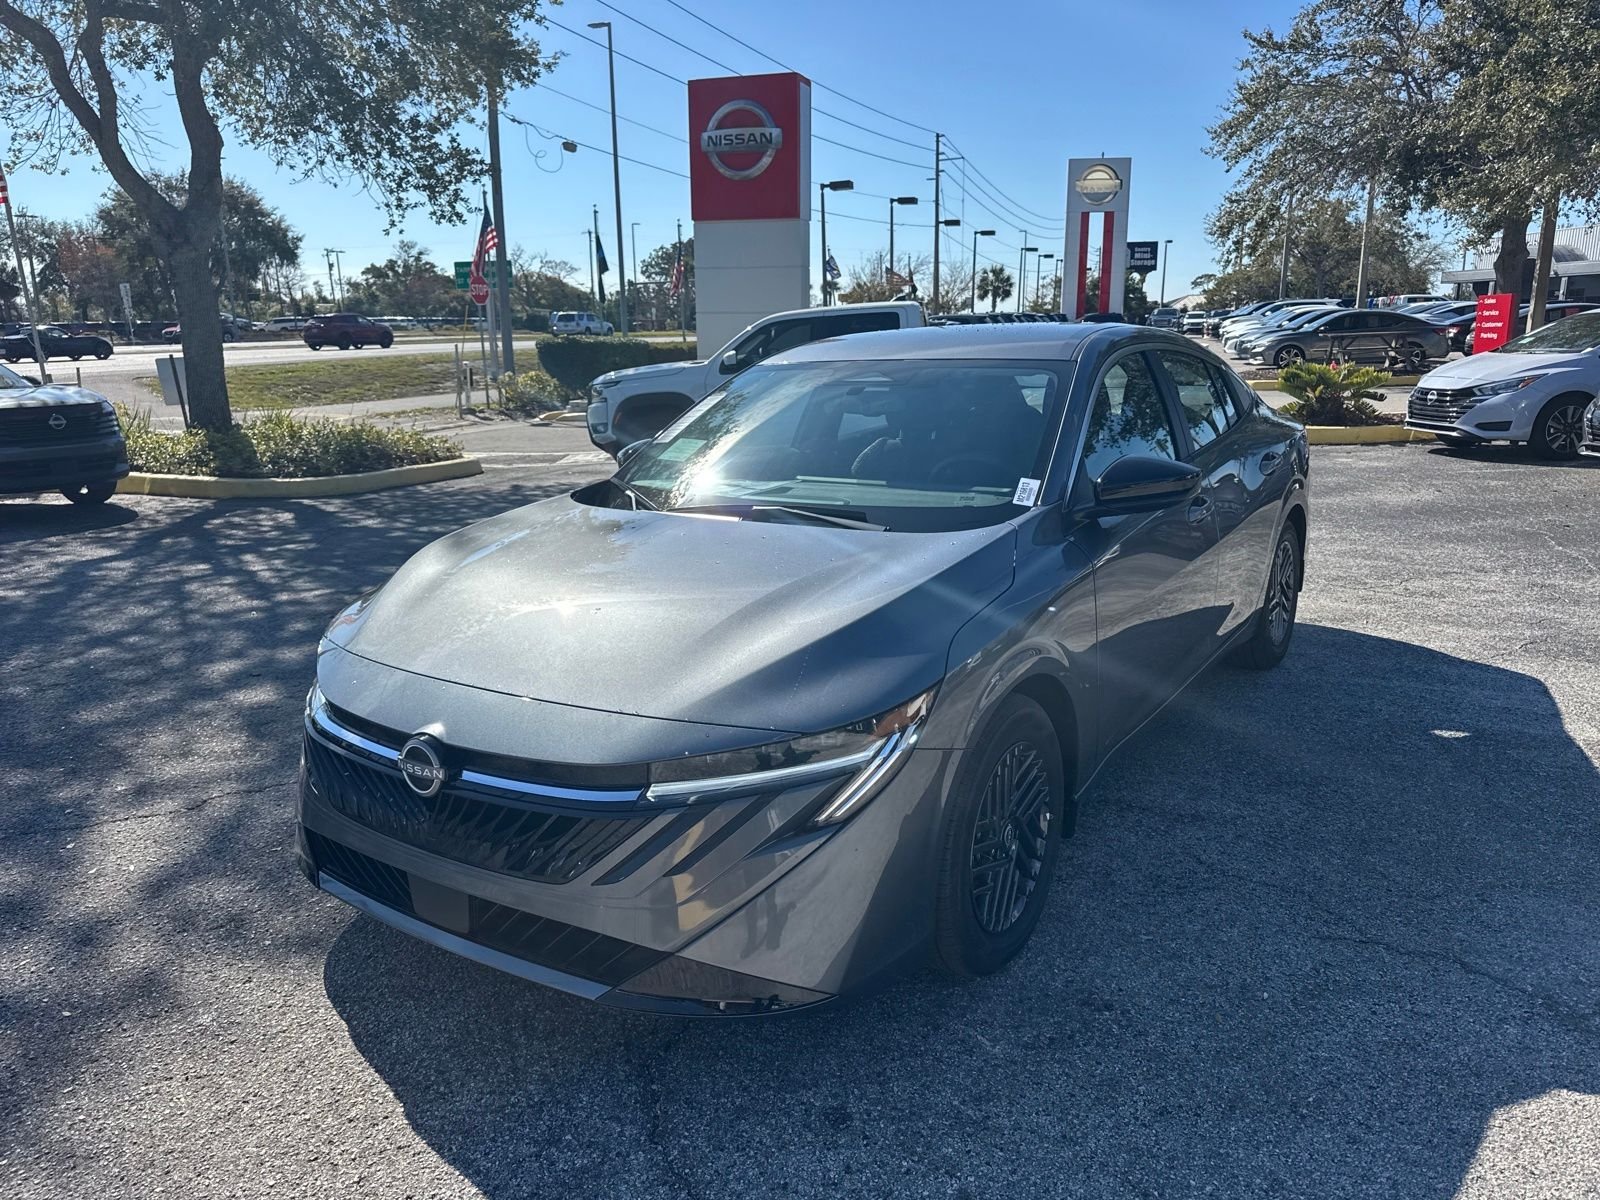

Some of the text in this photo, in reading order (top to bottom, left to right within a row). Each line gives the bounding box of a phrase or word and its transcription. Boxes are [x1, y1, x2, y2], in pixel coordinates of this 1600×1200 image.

[707, 132, 773, 147] NISSAN
[1479, 241, 1498, 255] New
[1130, 259, 1156, 267] Storage
[471, 284, 488, 296] STOP
[1480, 331, 1498, 340] Parking
[398, 760, 443, 779] NISSAN
